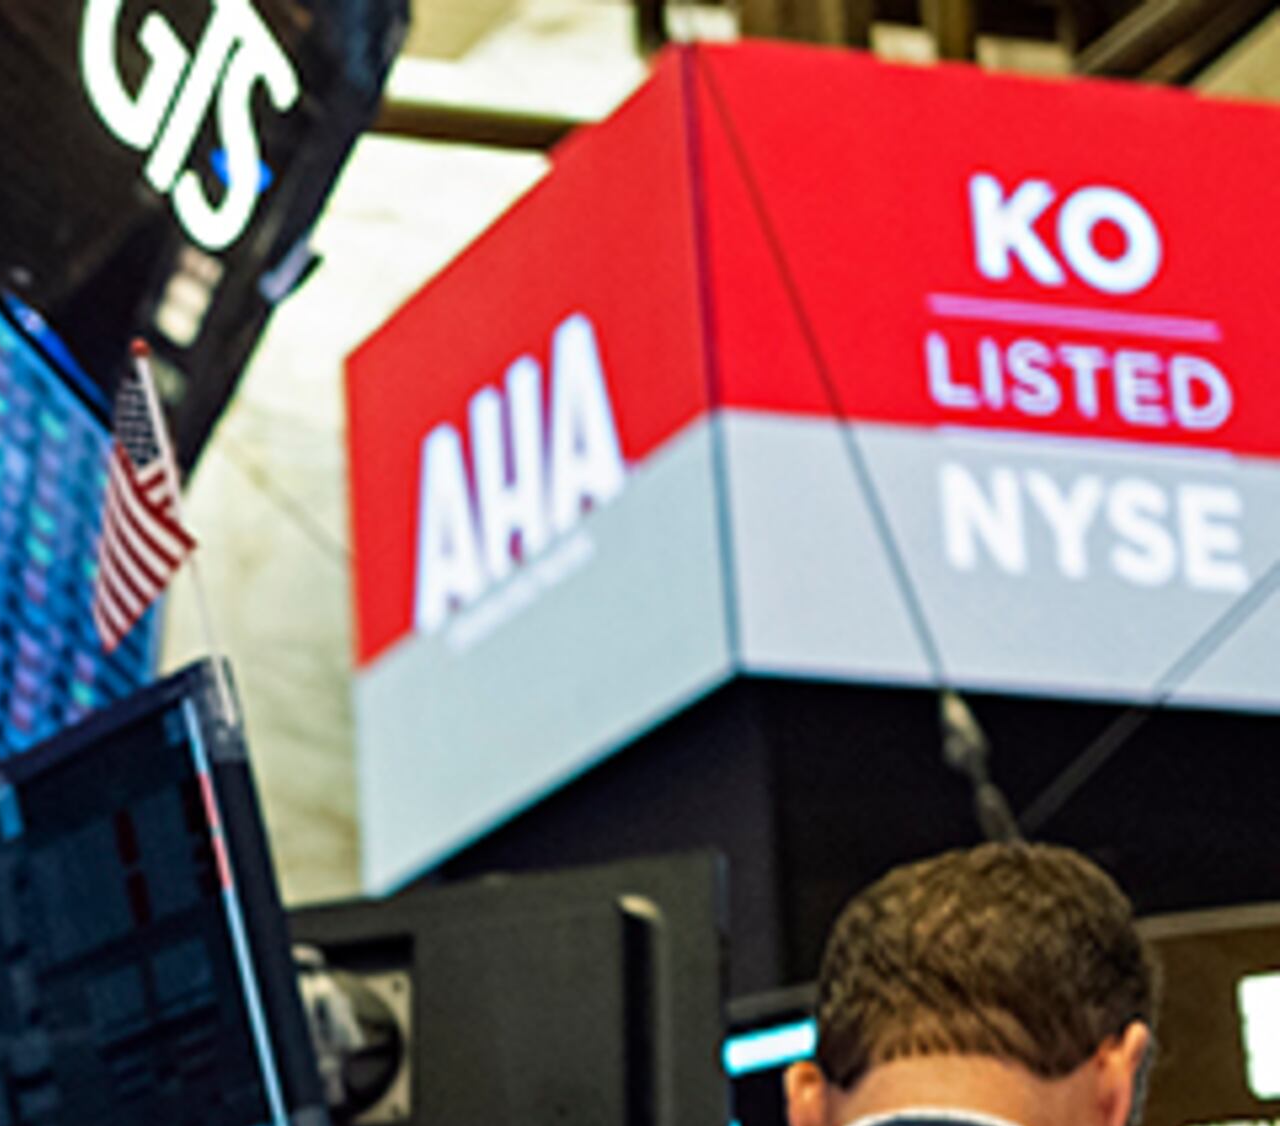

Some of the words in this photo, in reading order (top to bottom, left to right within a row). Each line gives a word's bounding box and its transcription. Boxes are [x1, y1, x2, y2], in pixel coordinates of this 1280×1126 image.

[969, 172, 1162, 295] KO
[925, 332, 1234, 432] LISTED
[413, 312, 628, 635] AHA
[940, 464, 1249, 593] NYSE
